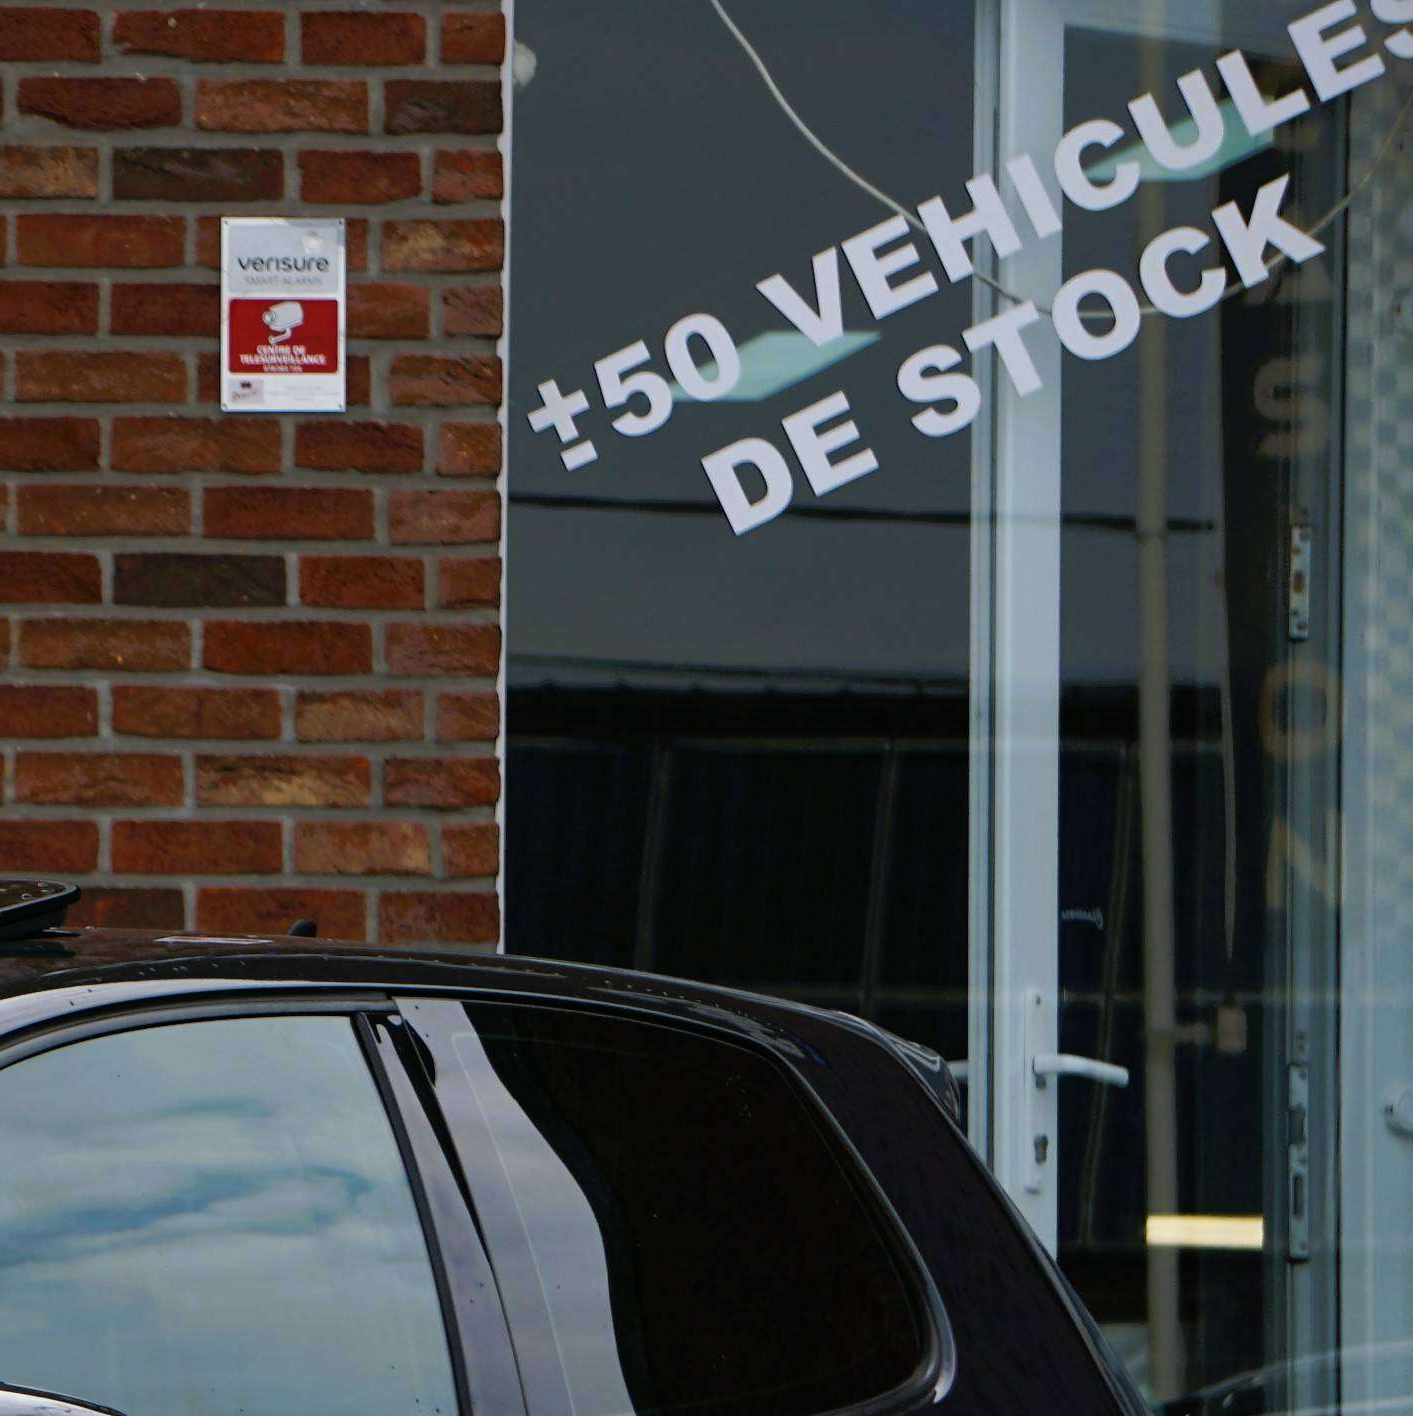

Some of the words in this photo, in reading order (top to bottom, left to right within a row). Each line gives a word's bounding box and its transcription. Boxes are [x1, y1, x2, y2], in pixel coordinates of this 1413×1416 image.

[237, 255, 329, 273] verisure
[700, 391, 879, 536] DE
[896, 173, 1325, 438] STOCK
